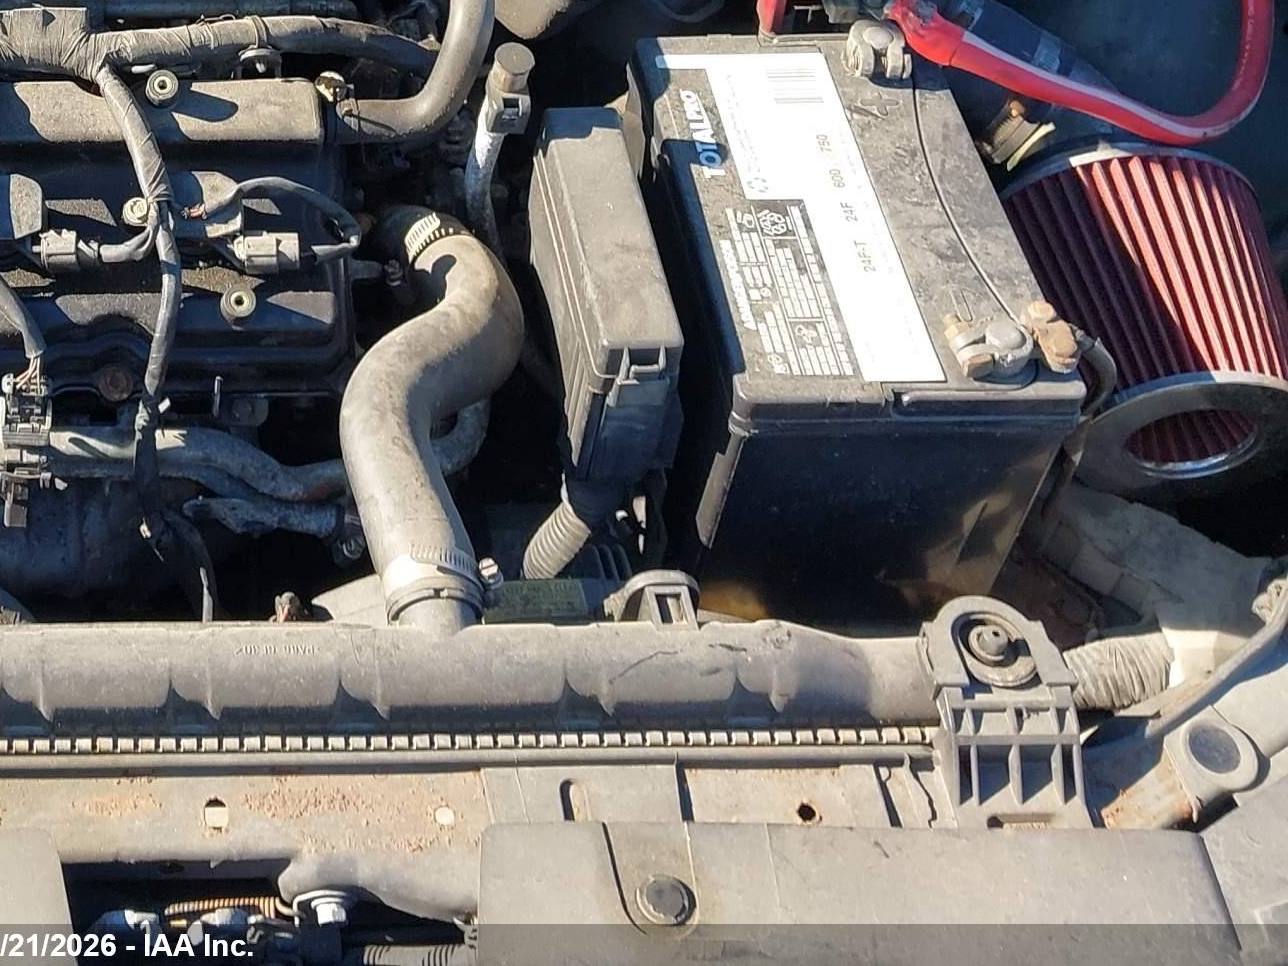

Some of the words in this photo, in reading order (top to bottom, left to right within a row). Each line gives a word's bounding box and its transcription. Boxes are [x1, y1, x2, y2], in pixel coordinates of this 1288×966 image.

[816, 134, 832, 154] 750
[829, 168, 846, 188] 600
[840, 201, 858, 223] 24F
[853, 240, 876, 273] 24F-T
